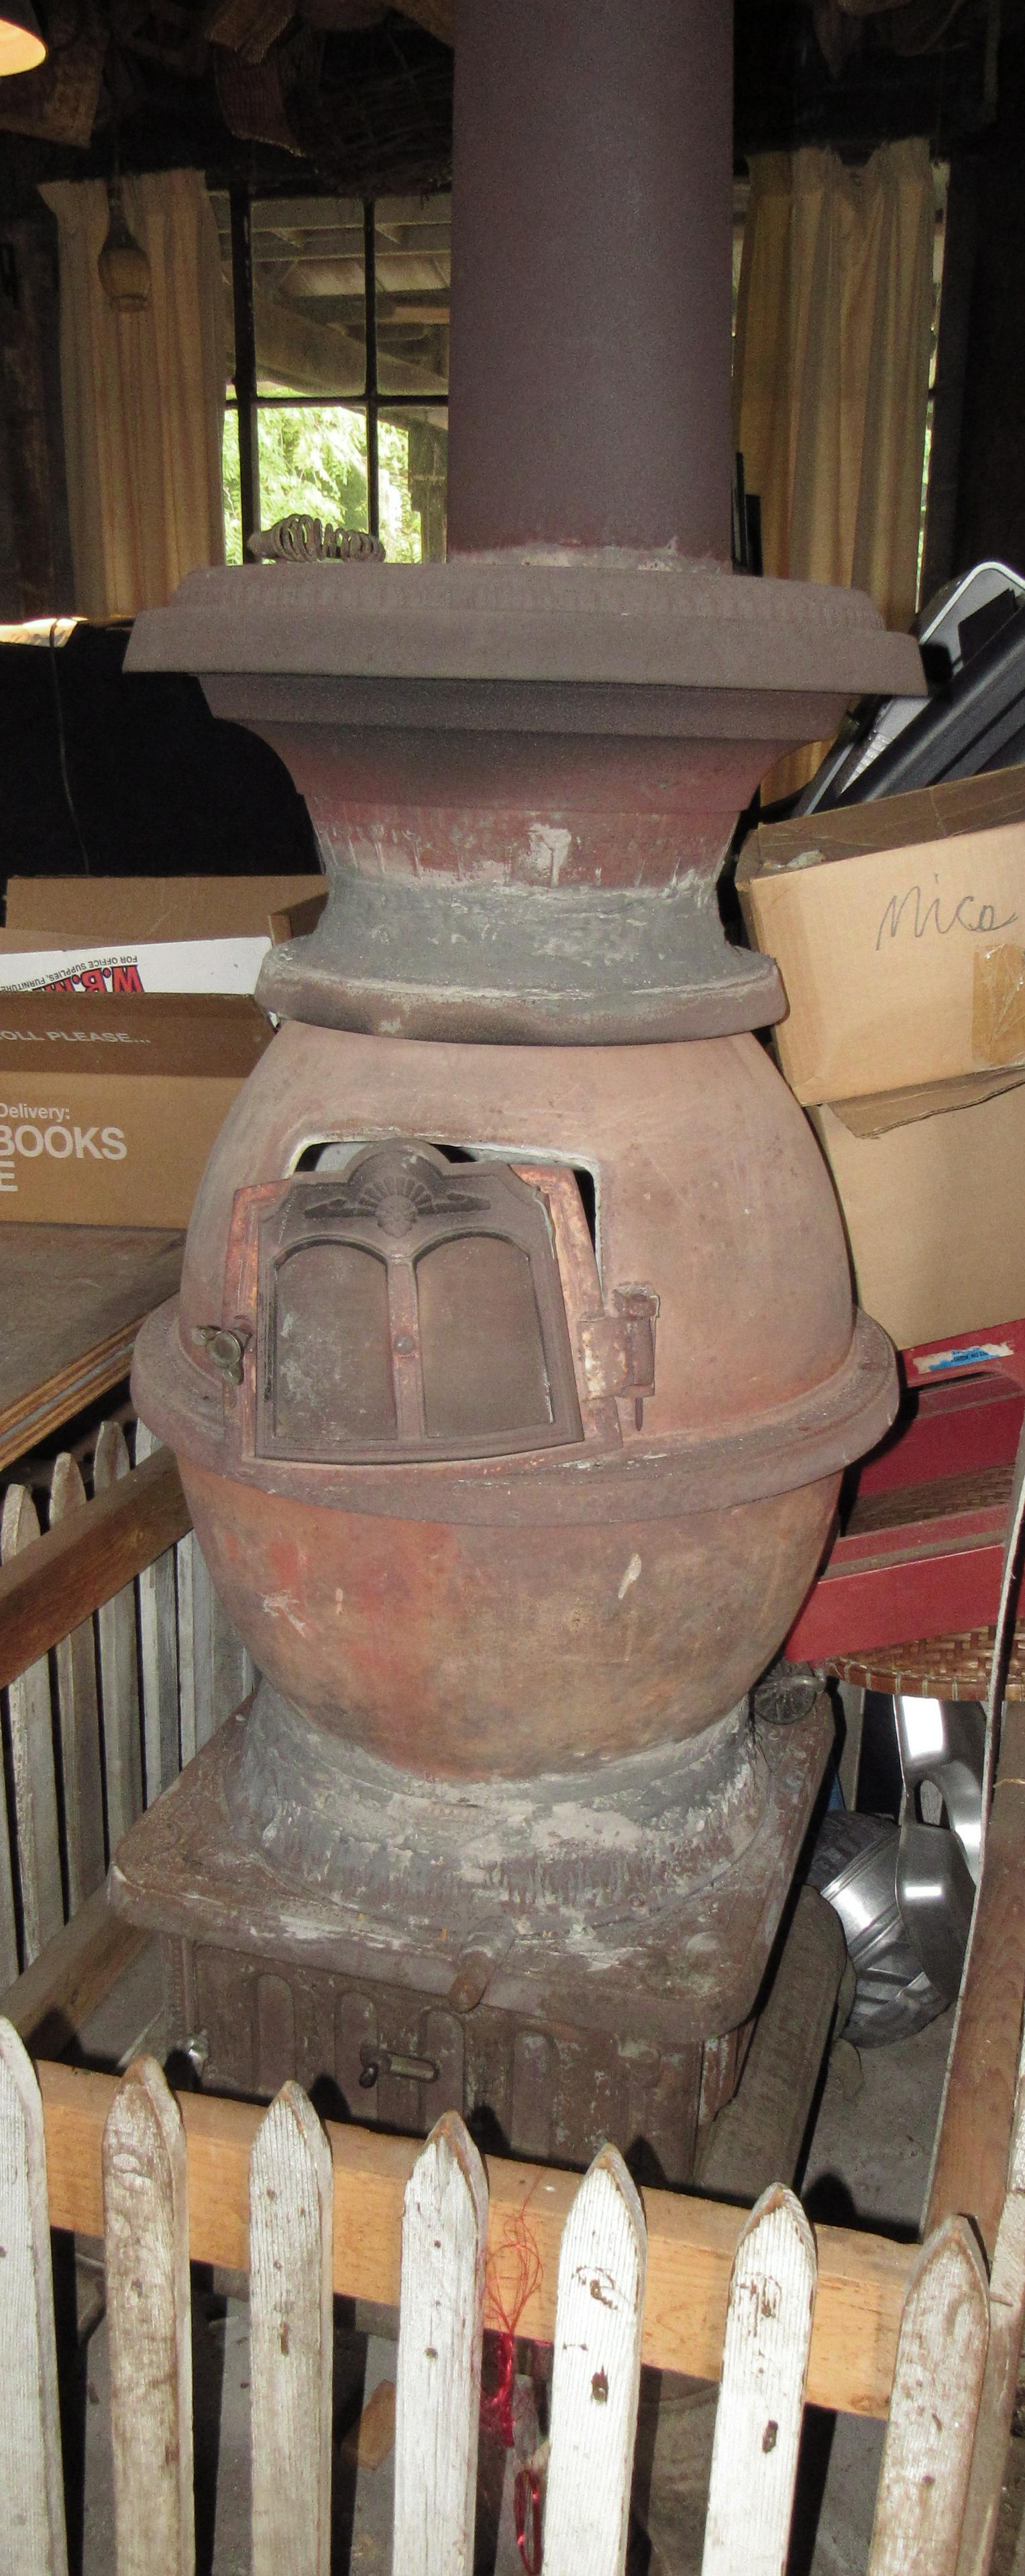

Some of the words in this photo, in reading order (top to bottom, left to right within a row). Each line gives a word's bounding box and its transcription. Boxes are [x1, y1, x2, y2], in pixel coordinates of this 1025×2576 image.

[88, 958, 118, 967] OFFICE
[121, 955, 138, 963] FOR
[46, 964, 87, 982] SUPPLIES,
[1, 977, 46, 992] FURNITURE
[0, 1102, 70, 1122] Delivery:
[0, 1124, 127, 1161] BOOKS
